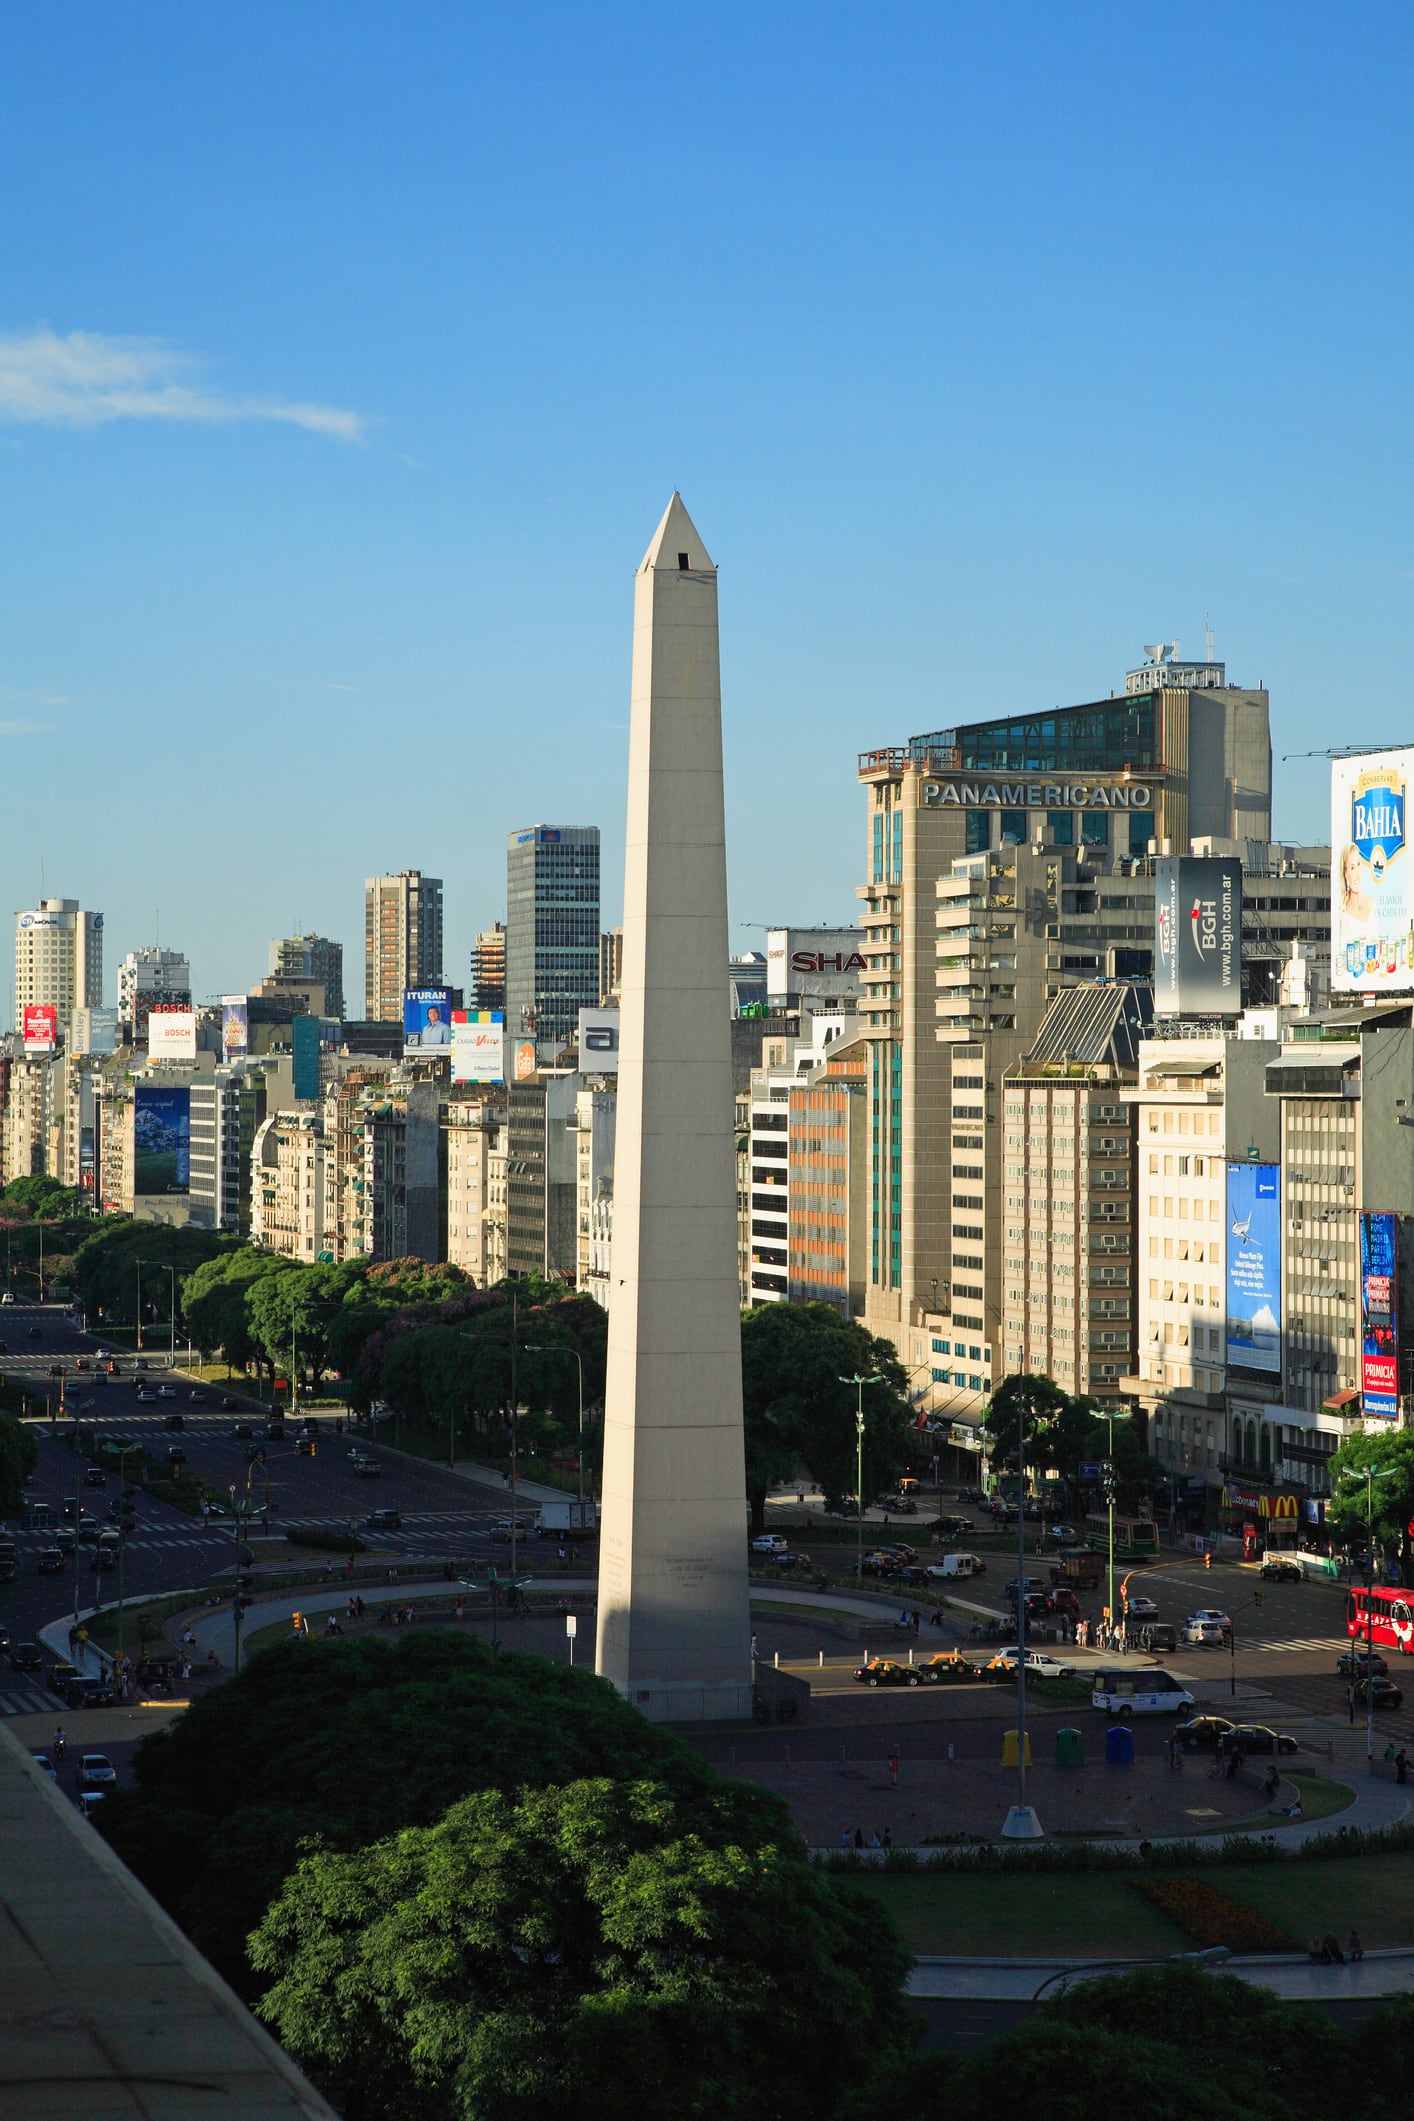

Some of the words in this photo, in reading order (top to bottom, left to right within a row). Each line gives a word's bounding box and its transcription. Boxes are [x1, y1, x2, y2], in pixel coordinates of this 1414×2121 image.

[1362, 775, 1394, 786] CONSERVAS
[922, 782, 1151, 807] PANAMERICANO
[1355, 804, 1402, 841] BAHIA
[1202, 901, 1217, 949] BGH
[1220, 875, 1234, 987] www.bgh.com.ar
[407, 991, 446, 1000] ITURAN
[155, 1004, 191, 1013] BOSCH
[76, 1011, 85, 1052] Berkley
[1365, 1362, 1394, 1379] PRIMICIA
